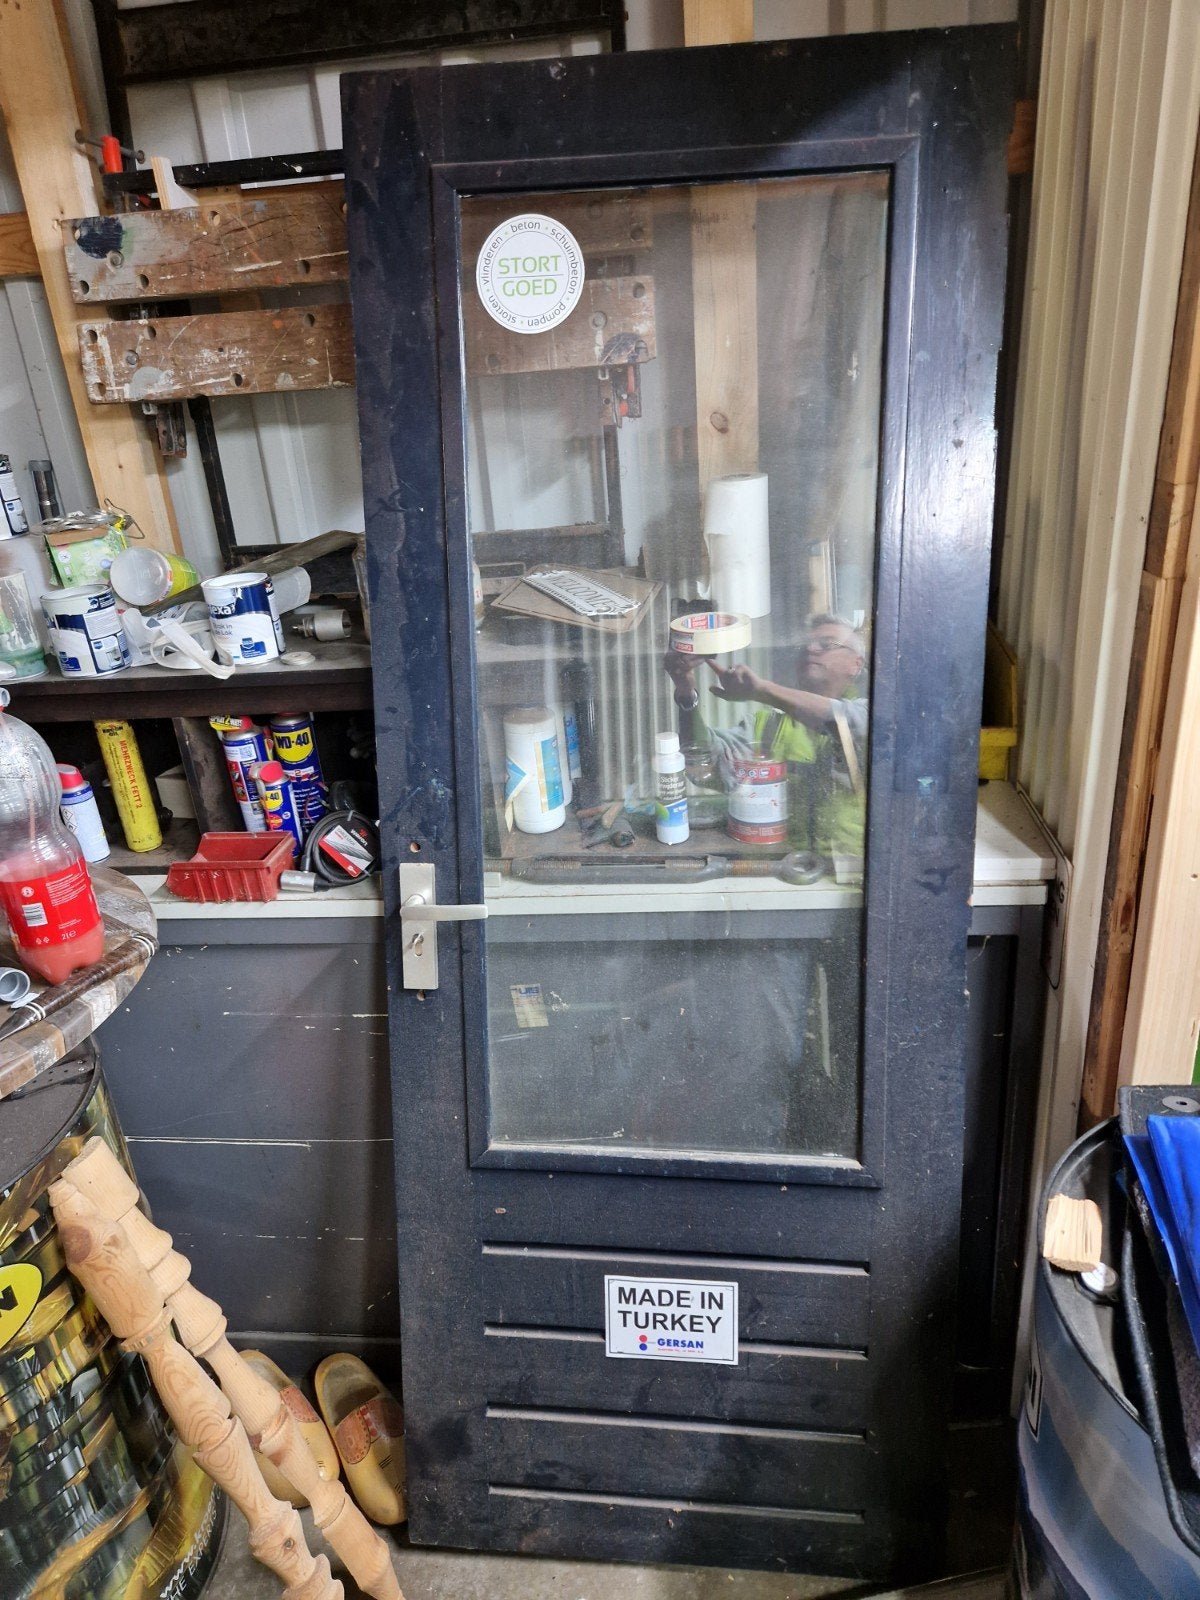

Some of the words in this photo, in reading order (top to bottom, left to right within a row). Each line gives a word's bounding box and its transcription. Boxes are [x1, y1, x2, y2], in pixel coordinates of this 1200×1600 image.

[511, 221, 541, 233] beton
[482, 236, 503, 285] vlinderen
[498, 255, 561, 275] STORT
[551, 228, 579, 294] schuimbeton
[502, 278, 558, 297] GOED
[488, 295, 517, 324] storten
[527, 302, 567, 327] pompen
[275, 732, 310, 750] WD-40
[119, 739, 137, 785] MEHRZWECK
[131, 784, 142, 802] FETT
[617, 1286, 692, 1309] MADE
[700, 1291, 724, 1311] IN
[617, 1309, 723, 1334] TURKEY
[657, 1338, 704, 1349] GERSAN
